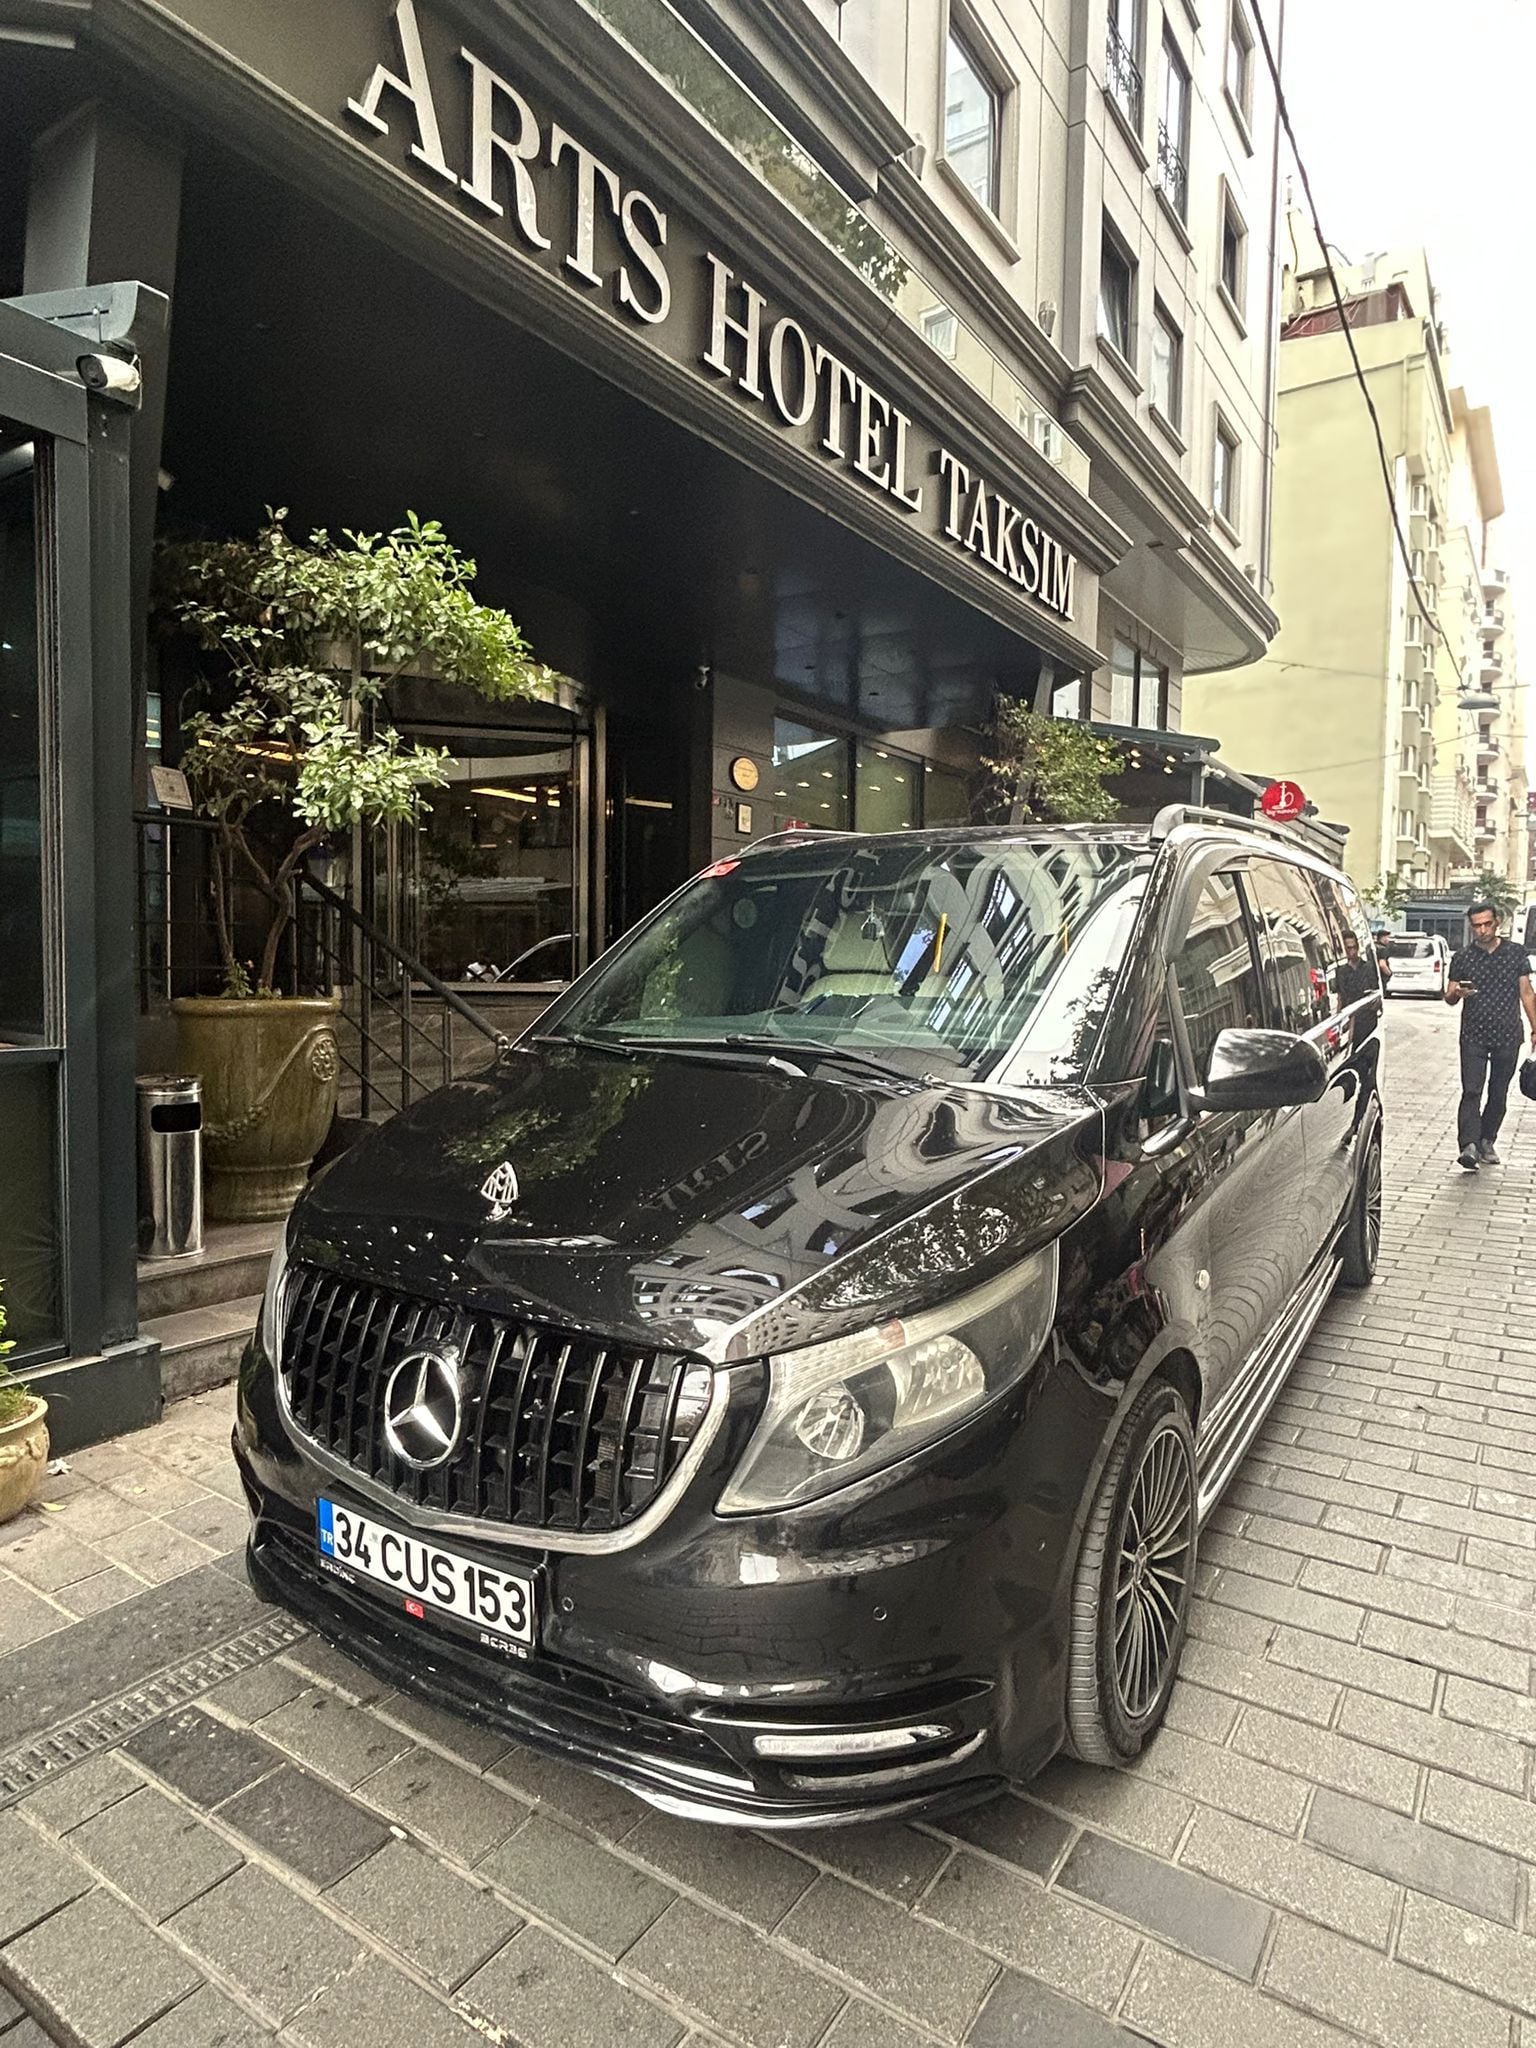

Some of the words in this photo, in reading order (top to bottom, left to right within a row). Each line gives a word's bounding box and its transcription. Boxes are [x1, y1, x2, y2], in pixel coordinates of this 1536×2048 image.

[347, 0, 671, 324] ARTS
[703, 251, 922, 513] HOTEL
[940, 448, 1077, 622] TAKSIM
[320, 1528, 334, 1547] TR
[334, 1511, 372, 1569] 34
[381, 1533, 456, 1604] CUS
[464, 1565, 527, 1632] 153
